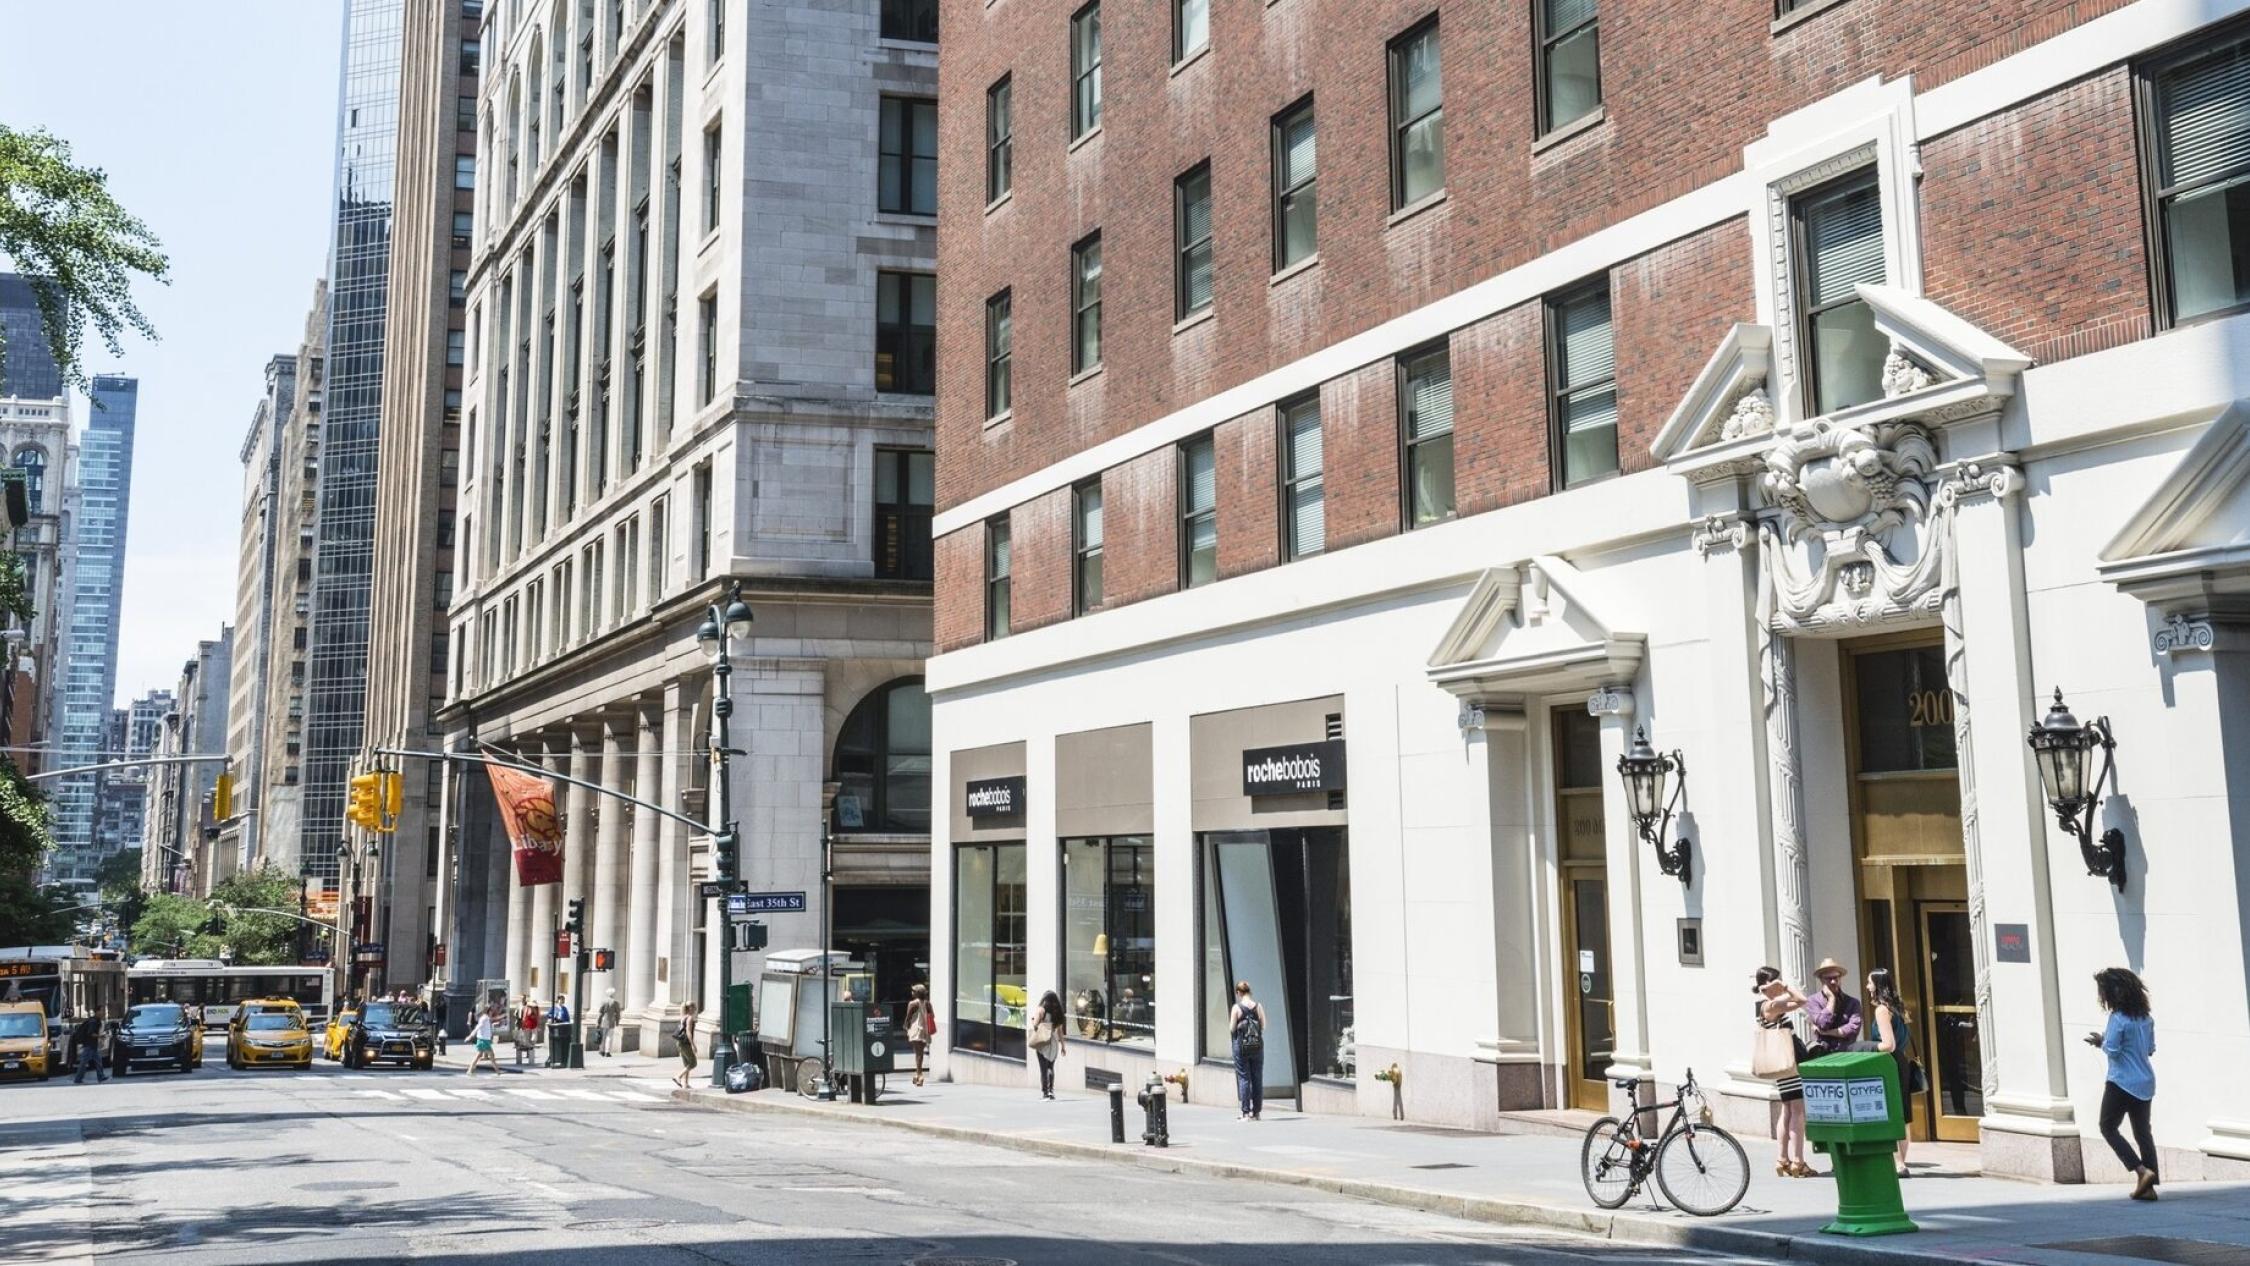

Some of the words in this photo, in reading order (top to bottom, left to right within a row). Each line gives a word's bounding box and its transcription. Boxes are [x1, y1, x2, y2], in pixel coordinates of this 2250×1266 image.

[1909, 689, 1953, 727] 200
[1247, 753, 1320, 782] rochebobois
[1296, 780, 1320, 788] PARIS
[969, 785, 1010, 807] rochebobois
[766, 897, 787, 908] 35th
[789, 897, 800, 907] St
[1804, 1085, 1844, 1099] CITYFIG
